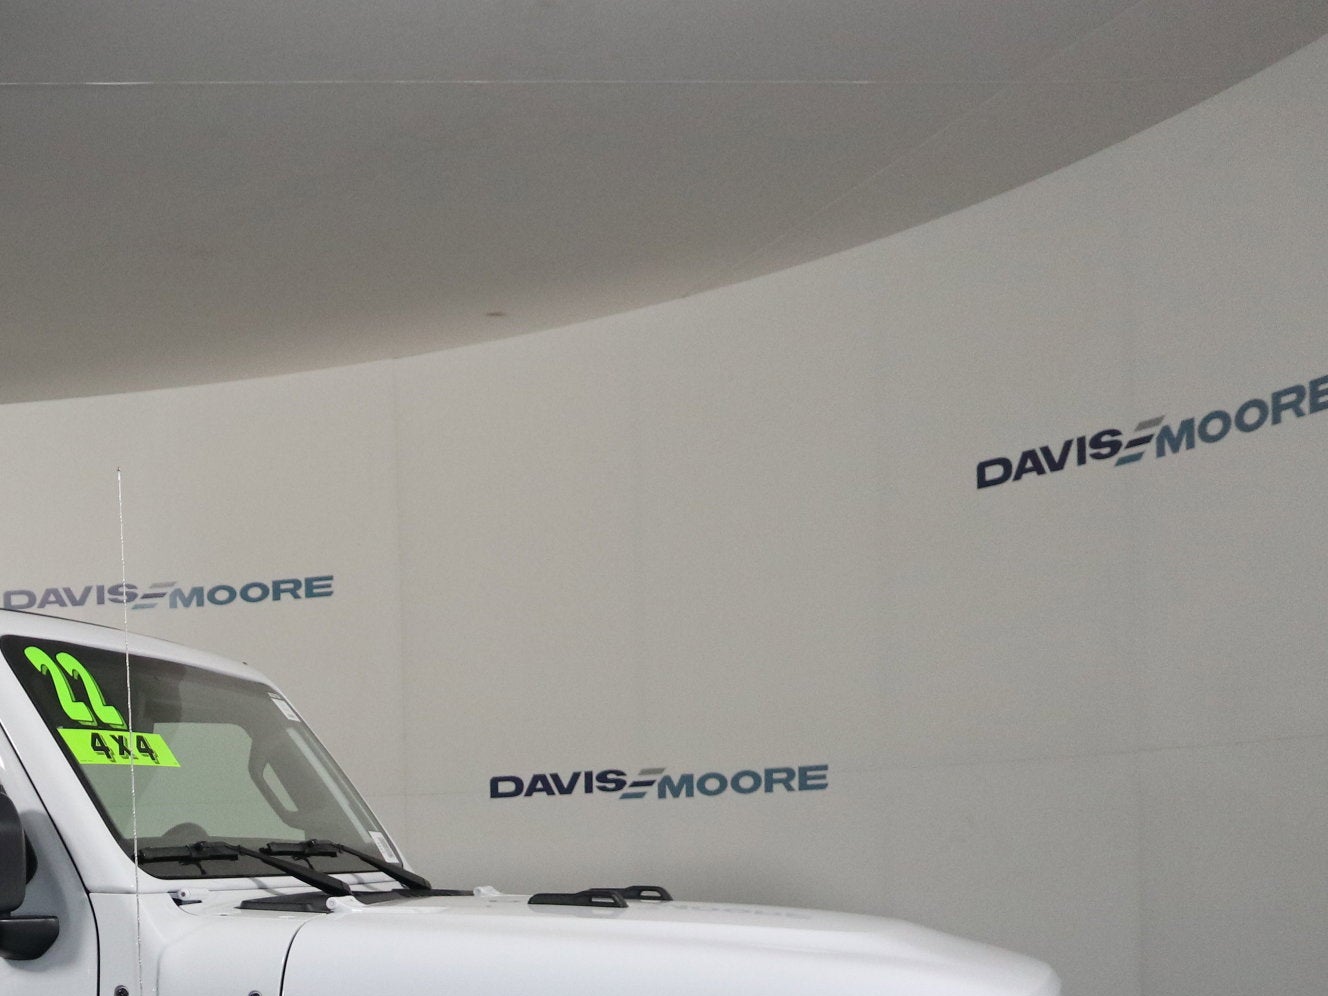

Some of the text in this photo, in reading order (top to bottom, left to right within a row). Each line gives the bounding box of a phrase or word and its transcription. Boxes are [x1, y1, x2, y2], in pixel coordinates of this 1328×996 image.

[976, 374, 1328, 489] DAVIS MOORE
[2, 574, 334, 612] DAVIS MOORE
[24, 645, 129, 730] 22
[489, 764, 830, 799] DAVIS MOORE
